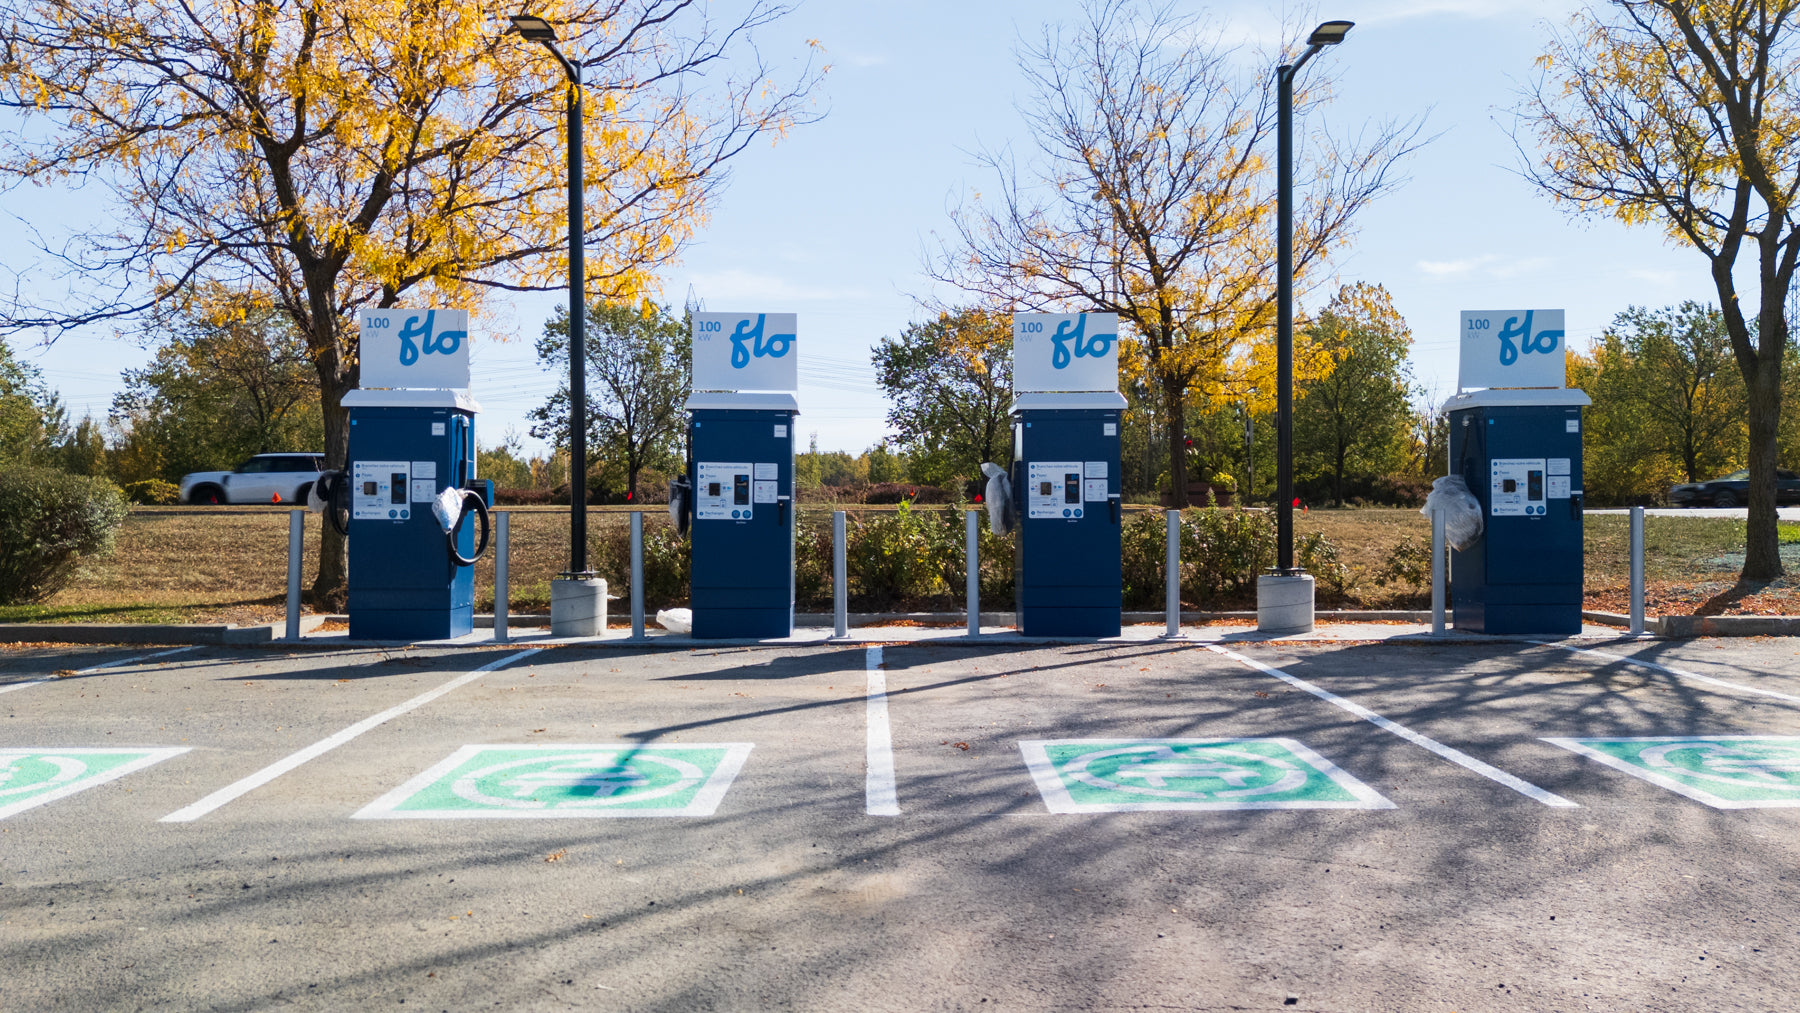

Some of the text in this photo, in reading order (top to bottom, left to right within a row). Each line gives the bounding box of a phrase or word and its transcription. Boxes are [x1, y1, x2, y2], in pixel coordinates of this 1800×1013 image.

[366, 317, 390, 329] 100
[698, 321, 721, 332] 100
[1020, 322, 1043, 333] 100
[1467, 319, 1490, 330] 100
[398, 310, 467, 366] flo
[698, 333, 712, 341] kW
[729, 313, 796, 369] flo
[1050, 313, 1118, 370] flo
[1497, 310, 1565, 366] flo
